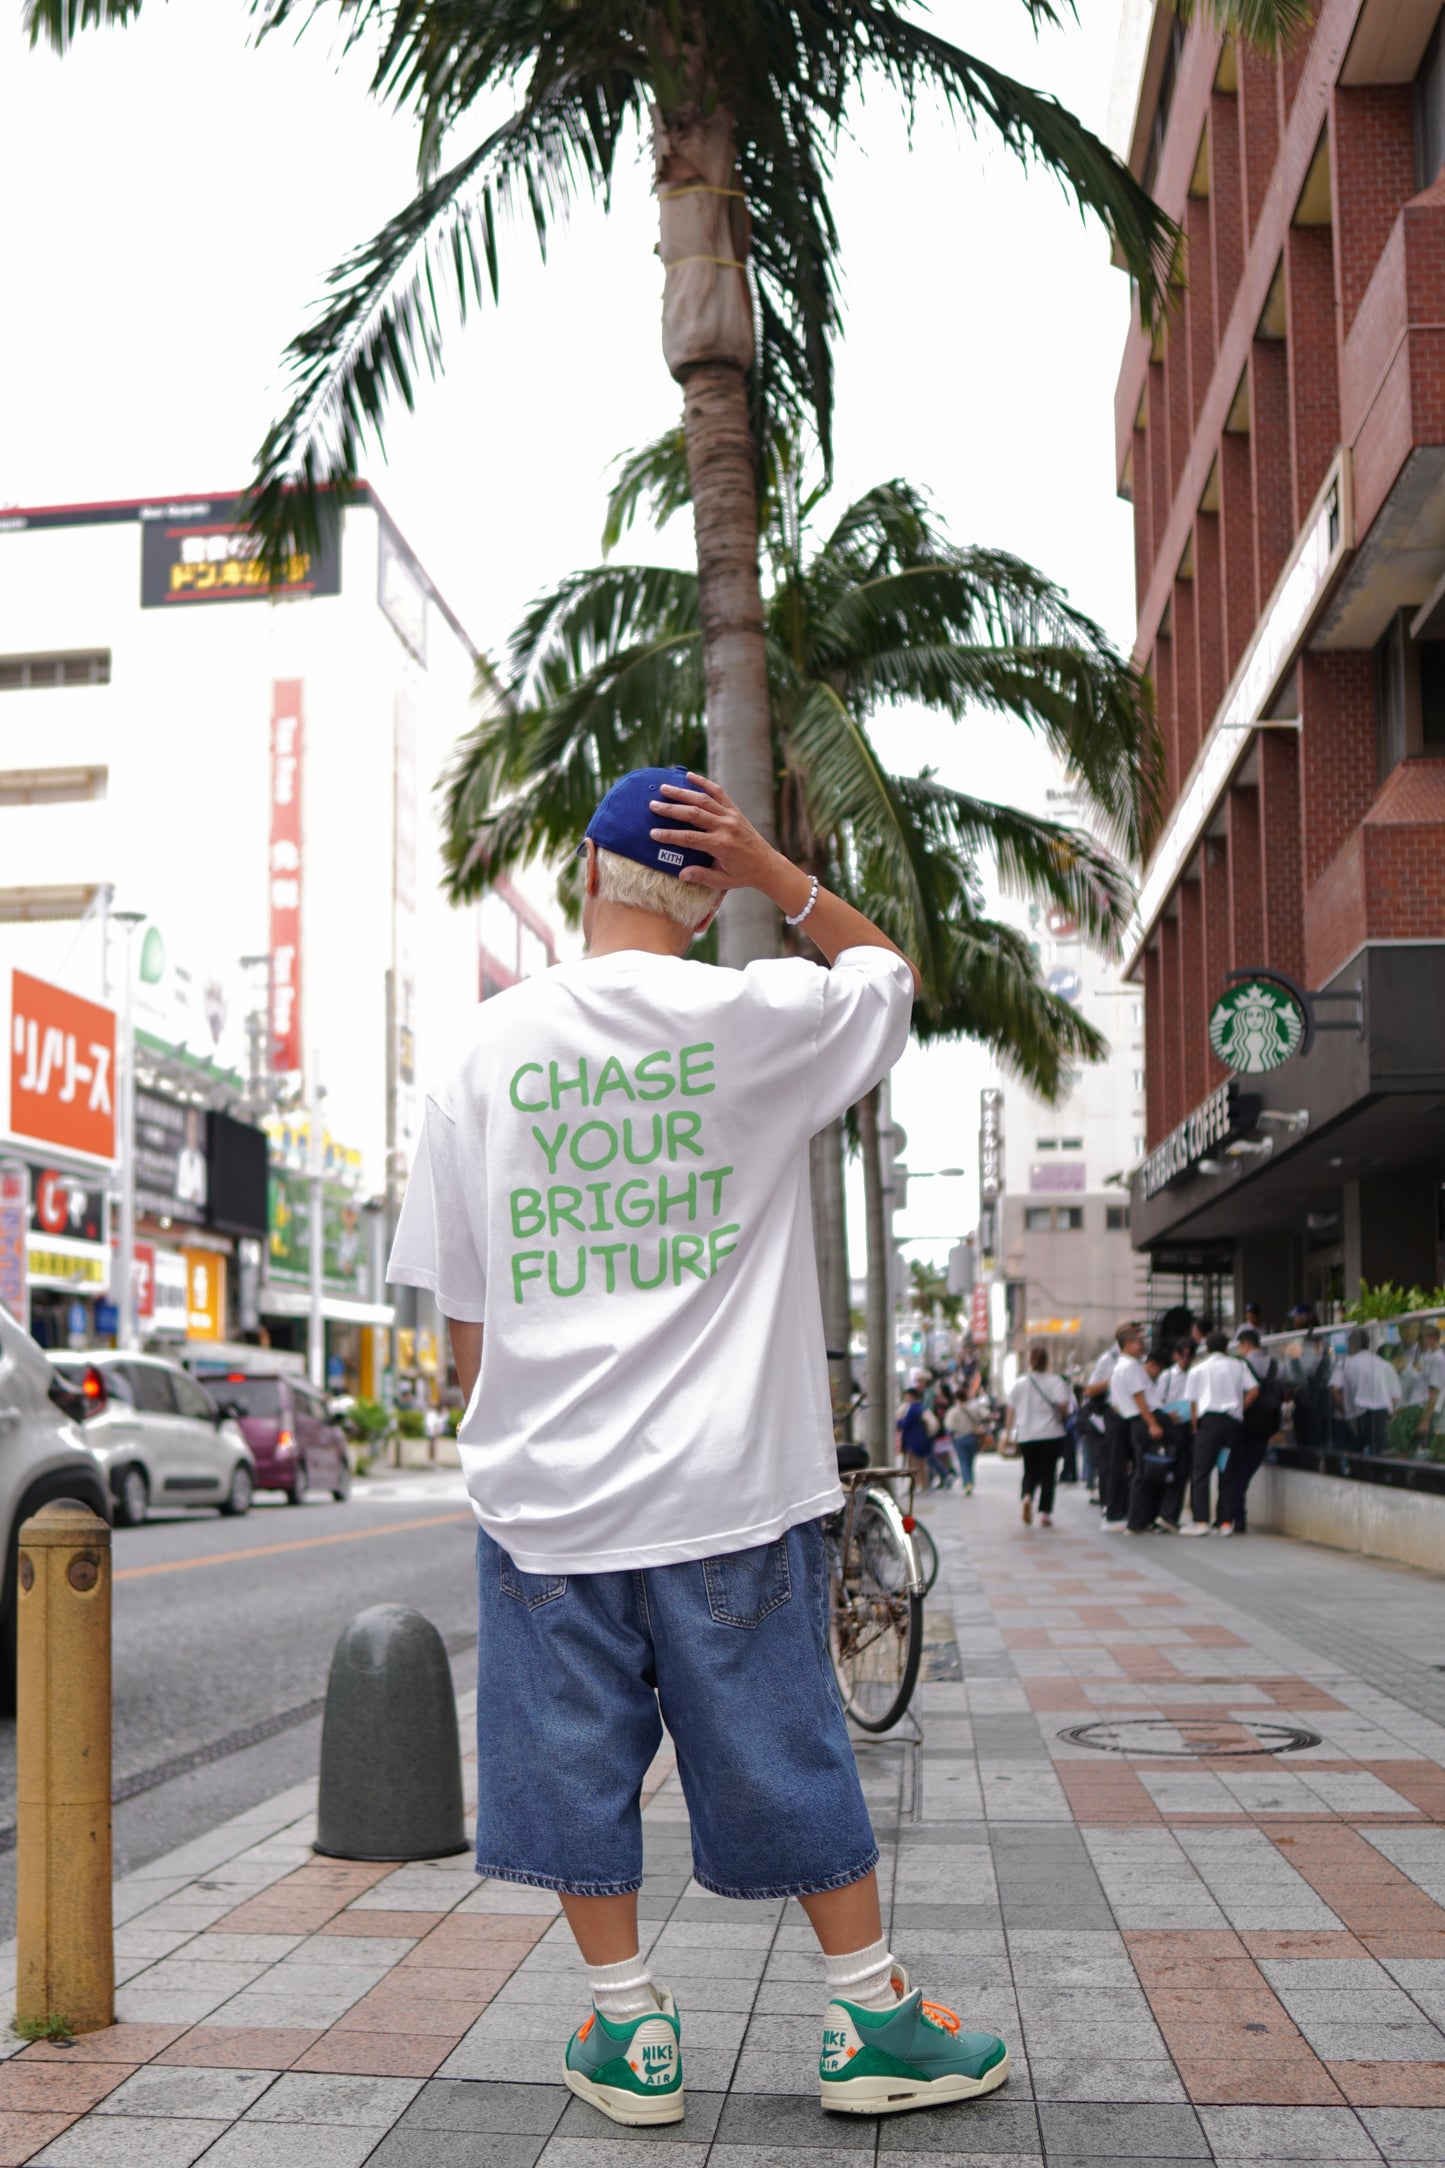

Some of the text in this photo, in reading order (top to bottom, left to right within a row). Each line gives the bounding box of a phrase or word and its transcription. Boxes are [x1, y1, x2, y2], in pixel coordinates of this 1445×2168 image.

[660, 850, 683, 864] KITH
[509, 1041, 716, 1113] CHASE
[1188, 1082, 1230, 1161] COFFEE
[531, 1110, 705, 1175] YOUR
[509, 1165, 735, 1239] BRIGHT
[511, 1223, 741, 1304] FUTURE
[642, 2044, 673, 2062] NIKE
[822, 2029, 846, 2047] NIKE
[646, 2073, 671, 2085] AIR
[820, 2059, 839, 2070] AIR
